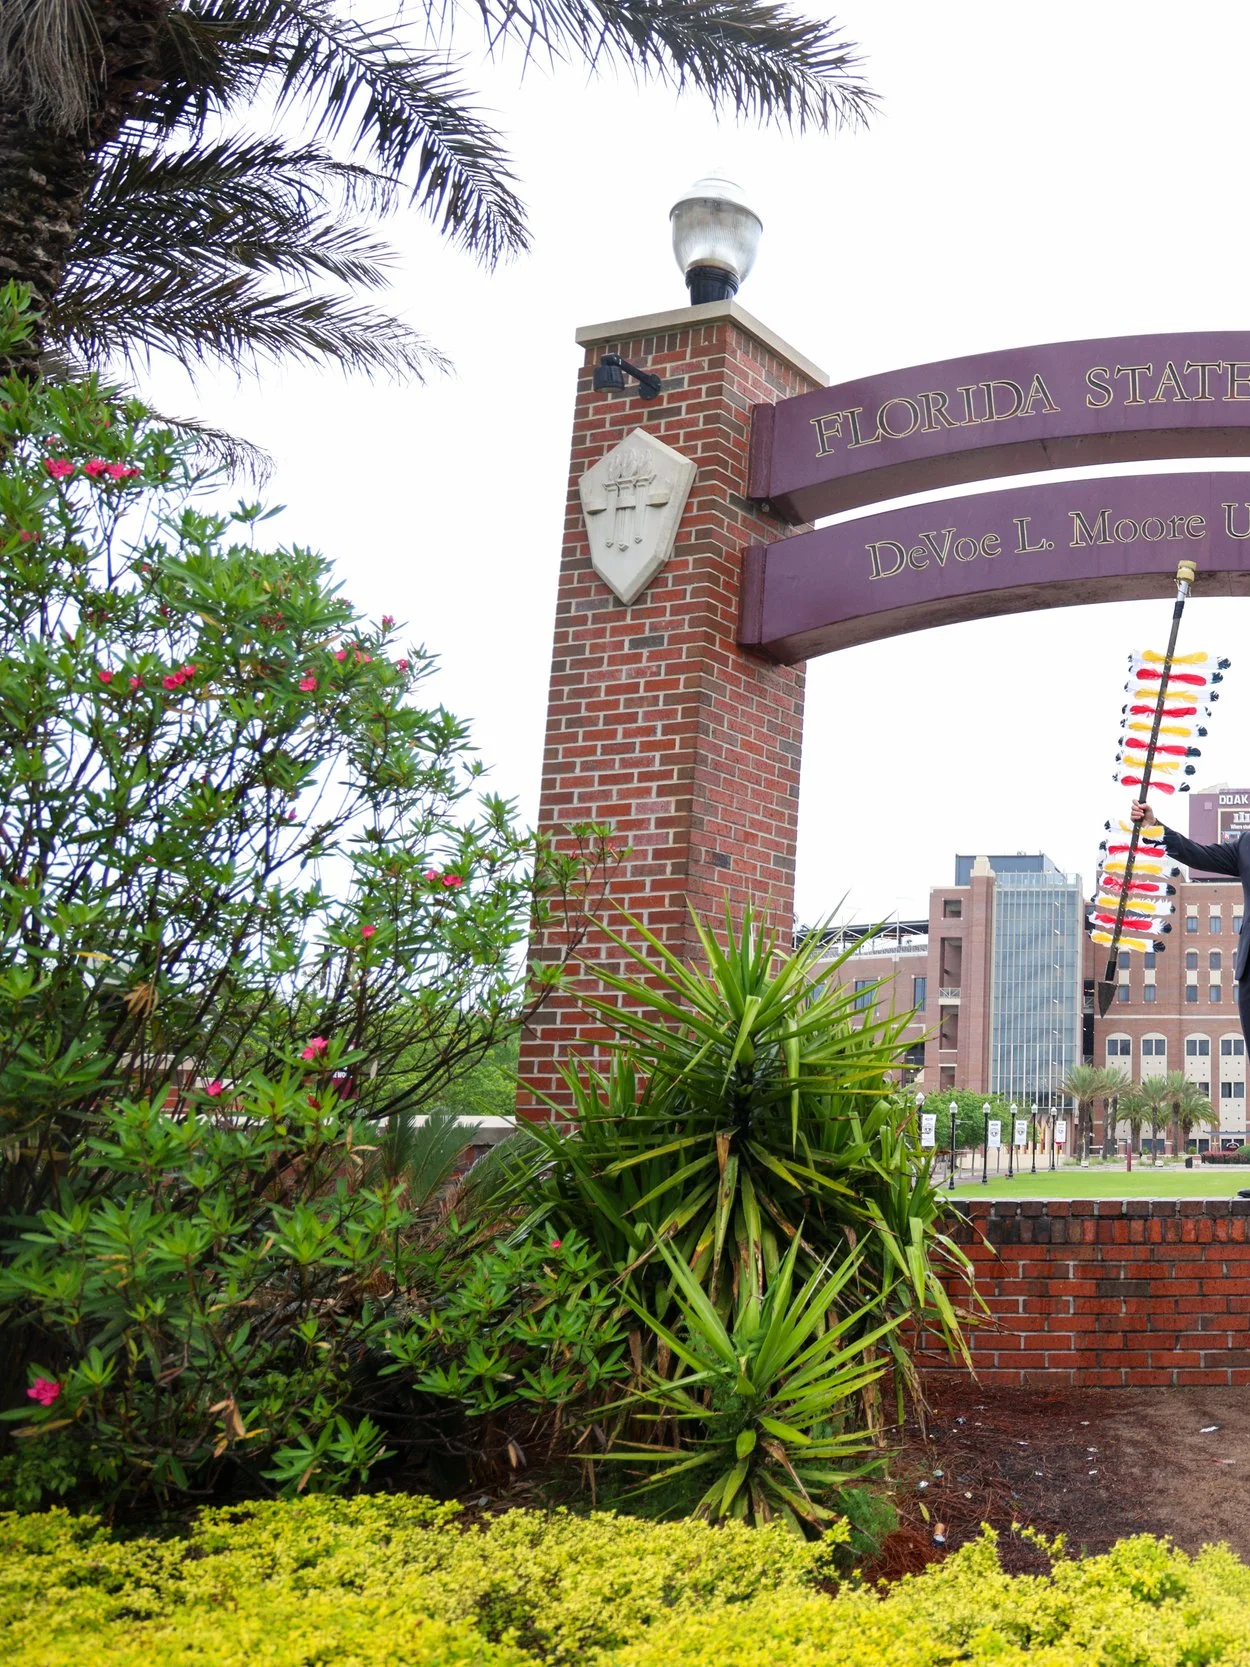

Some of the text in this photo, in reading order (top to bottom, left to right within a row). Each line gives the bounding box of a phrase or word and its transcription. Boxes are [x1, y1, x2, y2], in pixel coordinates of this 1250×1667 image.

[810, 374, 1060, 458] FLORIDA
[865, 527, 1001, 580] DeVoe
[1013, 516, 1055, 553] L.
[1068, 509, 1206, 547] Moore
[1219, 795, 1249, 804] DOAK
